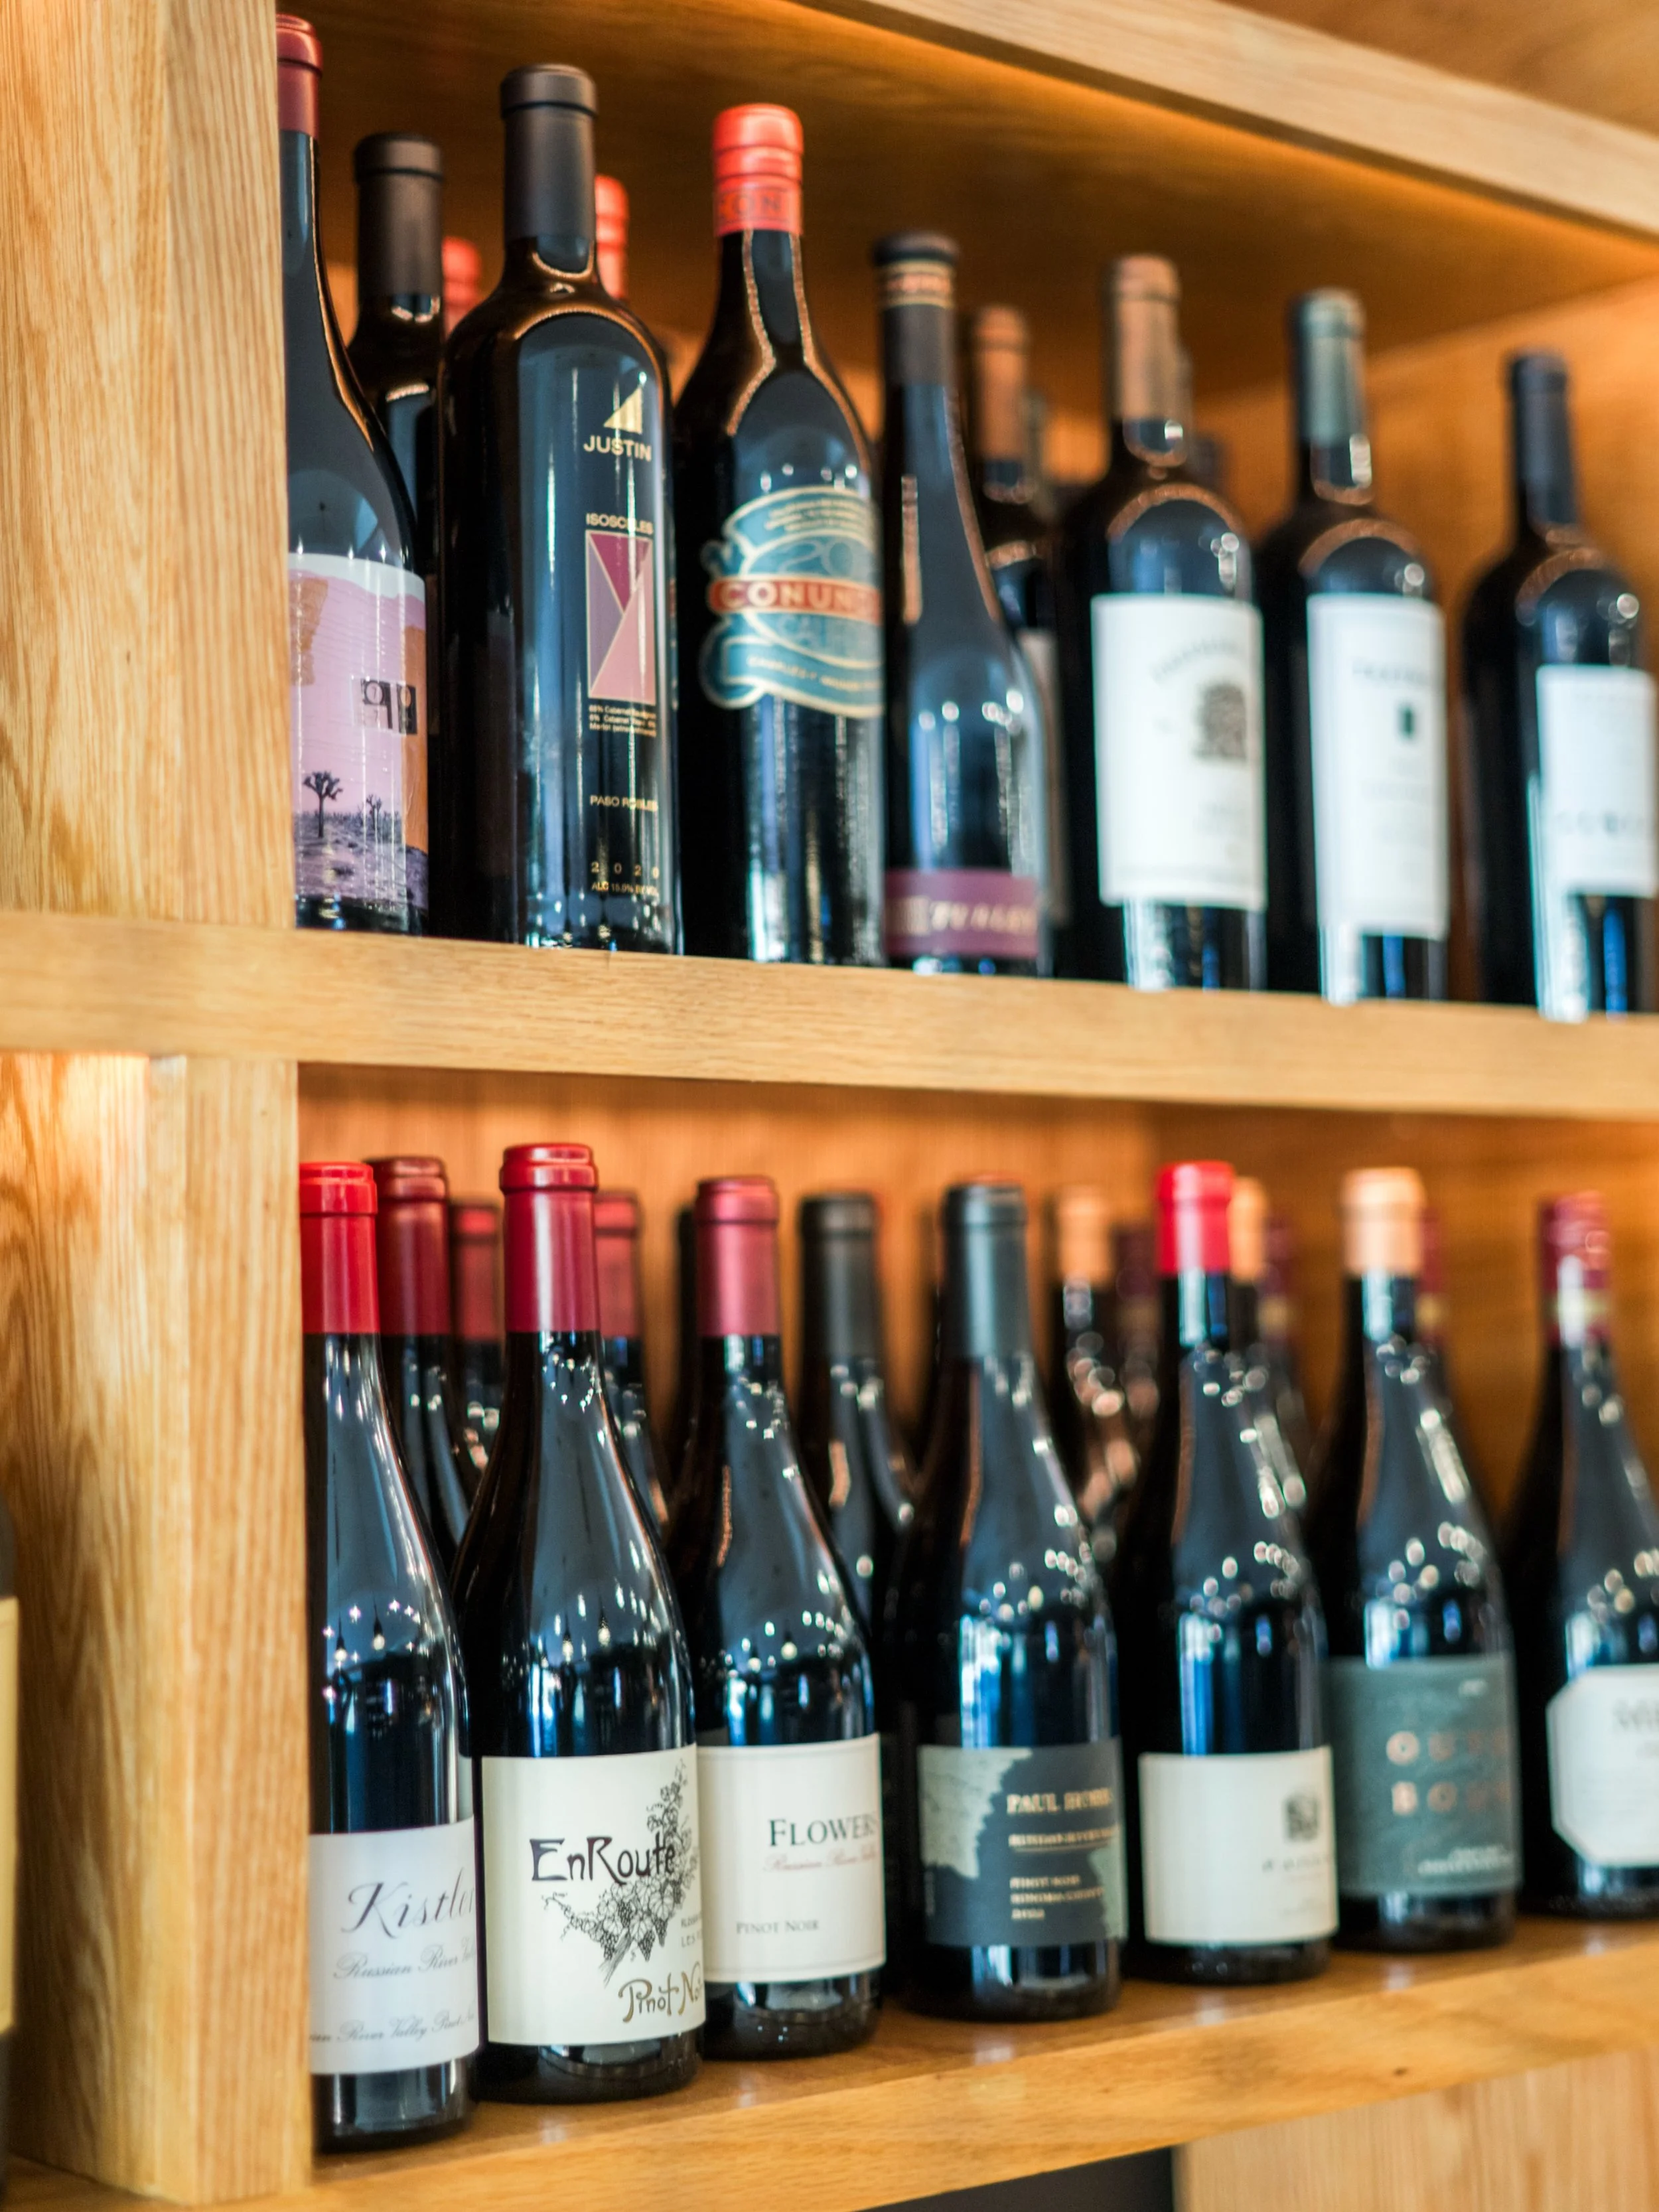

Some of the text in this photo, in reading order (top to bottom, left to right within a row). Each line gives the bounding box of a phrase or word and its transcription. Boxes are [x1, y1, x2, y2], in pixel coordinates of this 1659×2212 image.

[583, 435, 652, 462] JUSTIN
[586, 512, 654, 535] ISOSCLES
[590, 795, 620, 807] PASO
[1007, 1793, 1060, 1814] PAUL
[530, 1831, 676, 1885] EnRoute
[333, 1951, 413, 1979] Russian
[418, 1943, 459, 1972] River
[618, 1972, 680, 2023] Pinot
